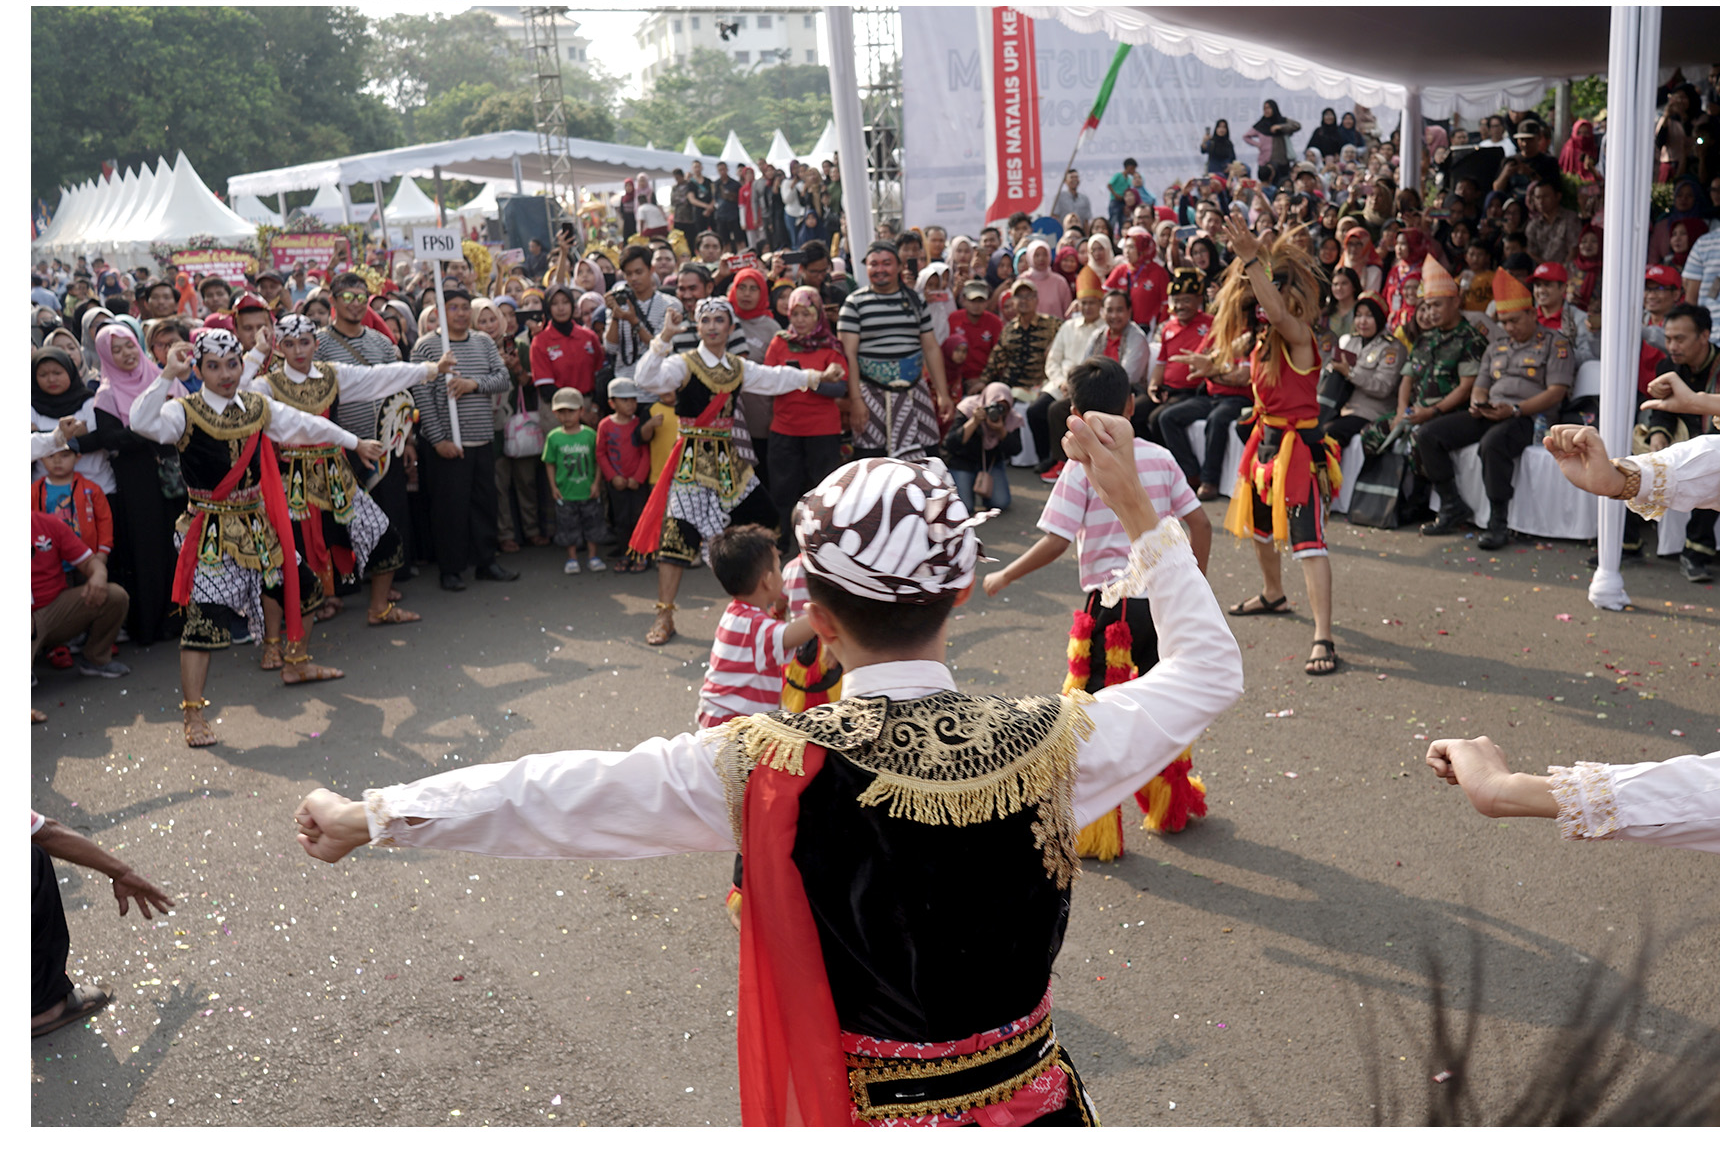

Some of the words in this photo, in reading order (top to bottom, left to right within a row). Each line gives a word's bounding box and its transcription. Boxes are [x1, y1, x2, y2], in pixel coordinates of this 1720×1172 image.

[1003, 40, 1020, 73] UPI
[1004, 75, 1022, 154] NATALIS
[1006, 156, 1024, 200] DIES
[422, 235, 455, 251] FPSD
